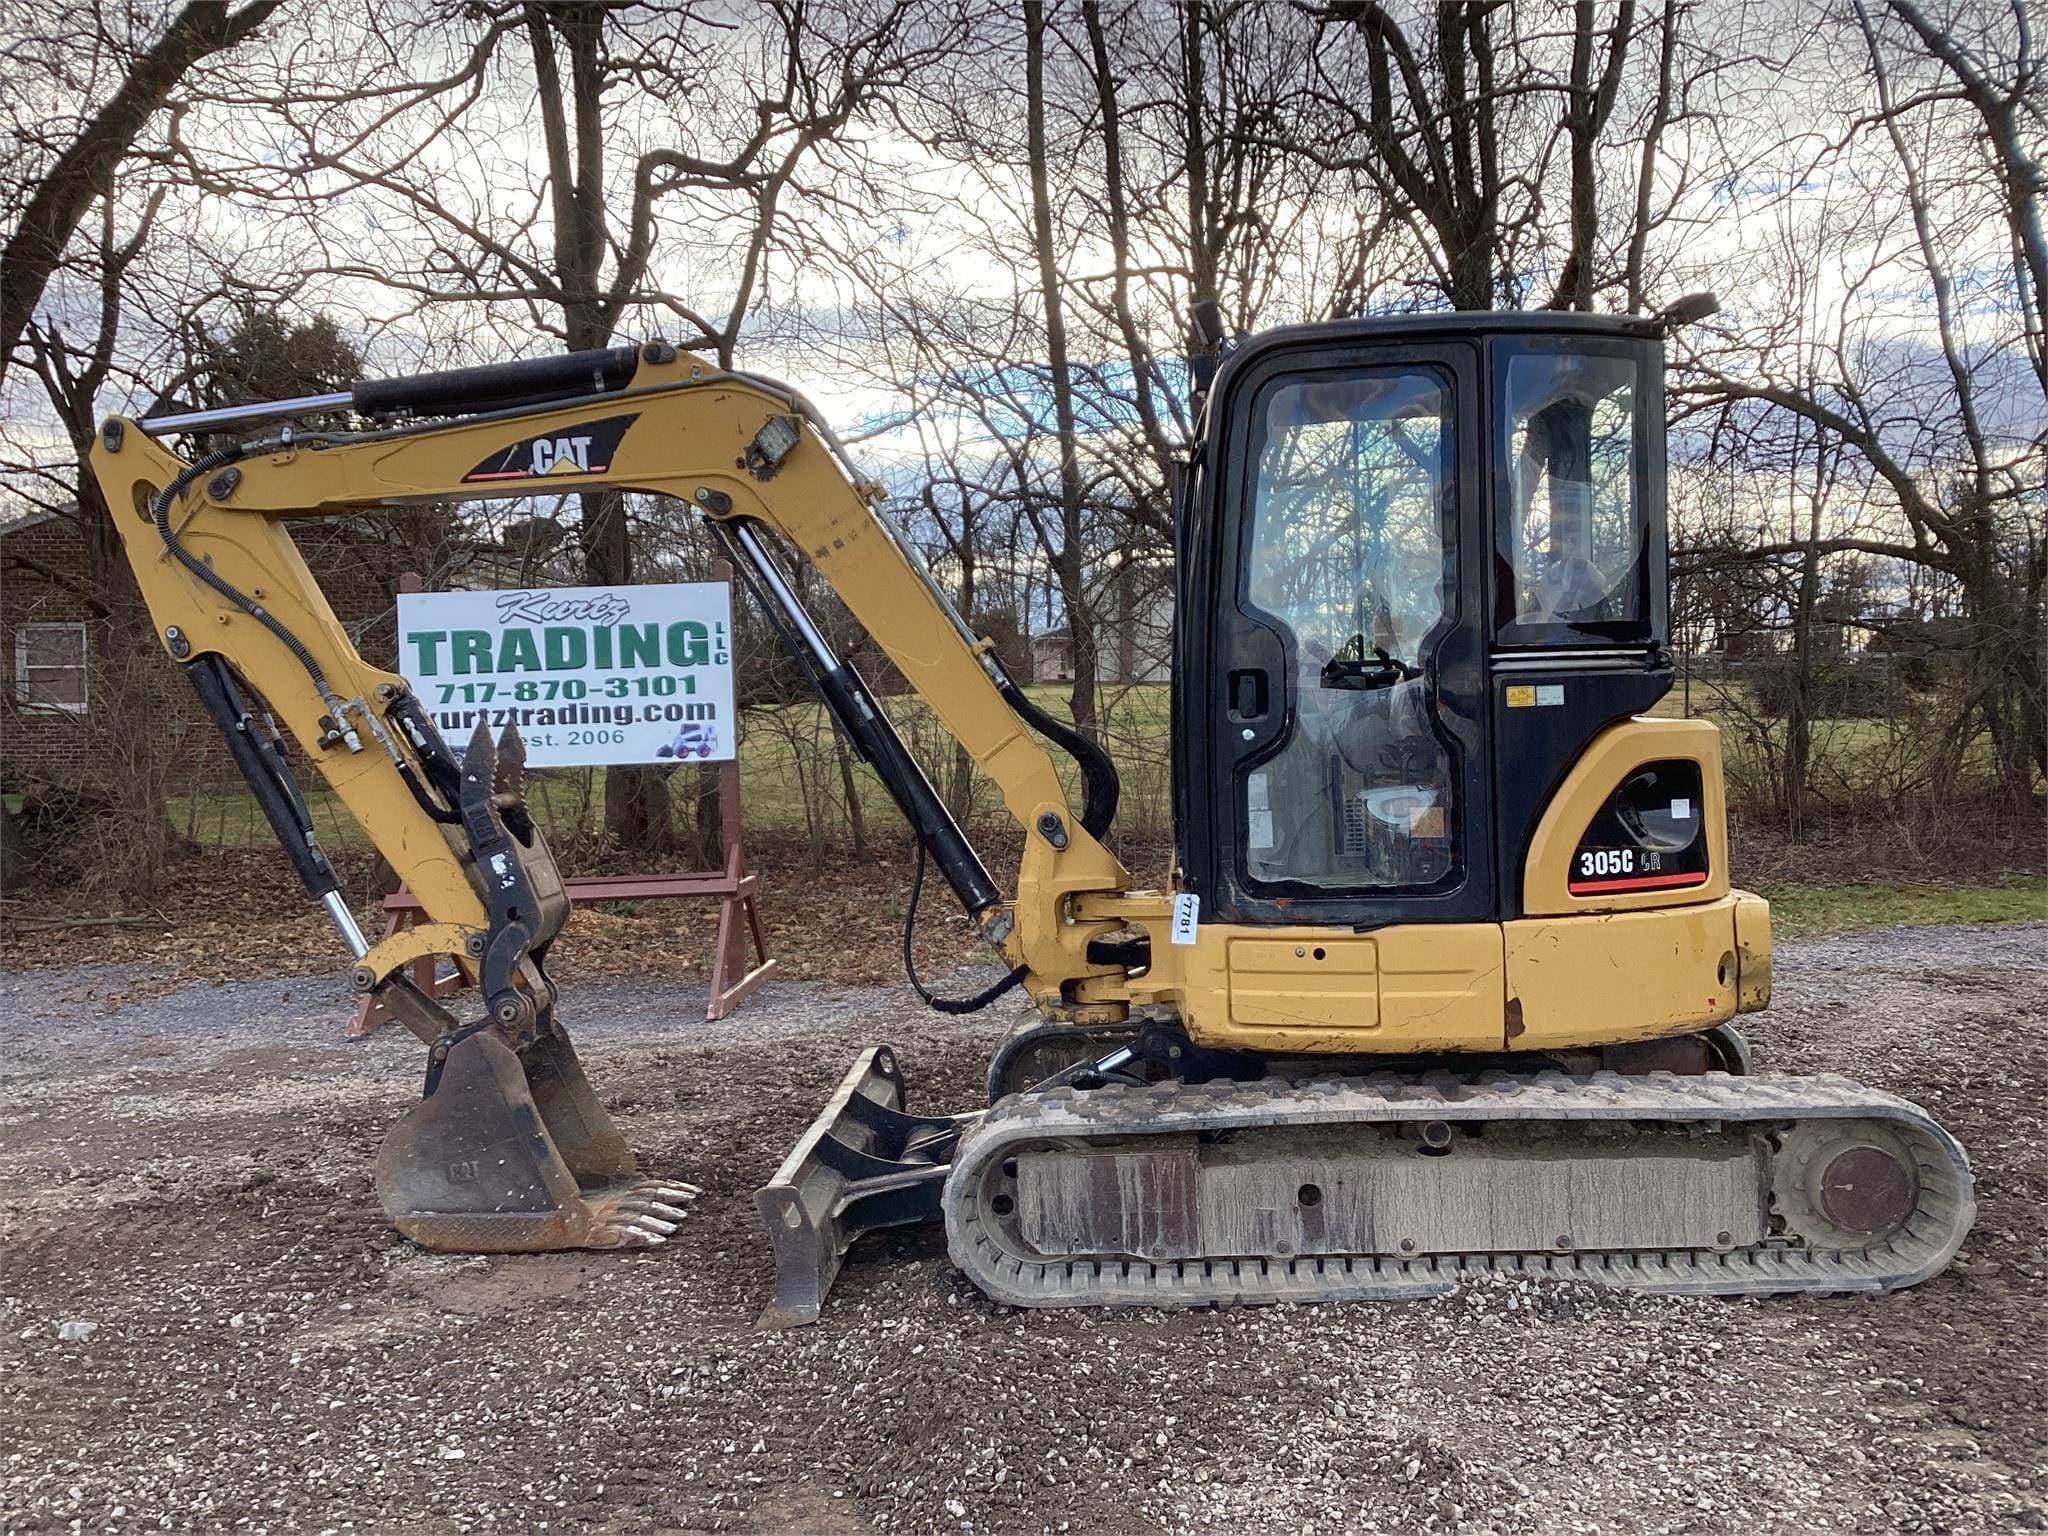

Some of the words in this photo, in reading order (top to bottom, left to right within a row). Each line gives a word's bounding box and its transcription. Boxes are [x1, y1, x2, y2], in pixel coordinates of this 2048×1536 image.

[532, 436, 593, 475] CAT
[496, 591, 631, 628] Kurtz
[407, 620, 710, 676] TRADING
[714, 621, 729, 665] LLC
[435, 675, 697, 704] 717-870-3101
[430, 702, 716, 729] urtztrading.com
[567, 730, 625, 746] 2006
[1580, 849, 1634, 876] 305C
[1180, 901, 1193, 934] 7781
